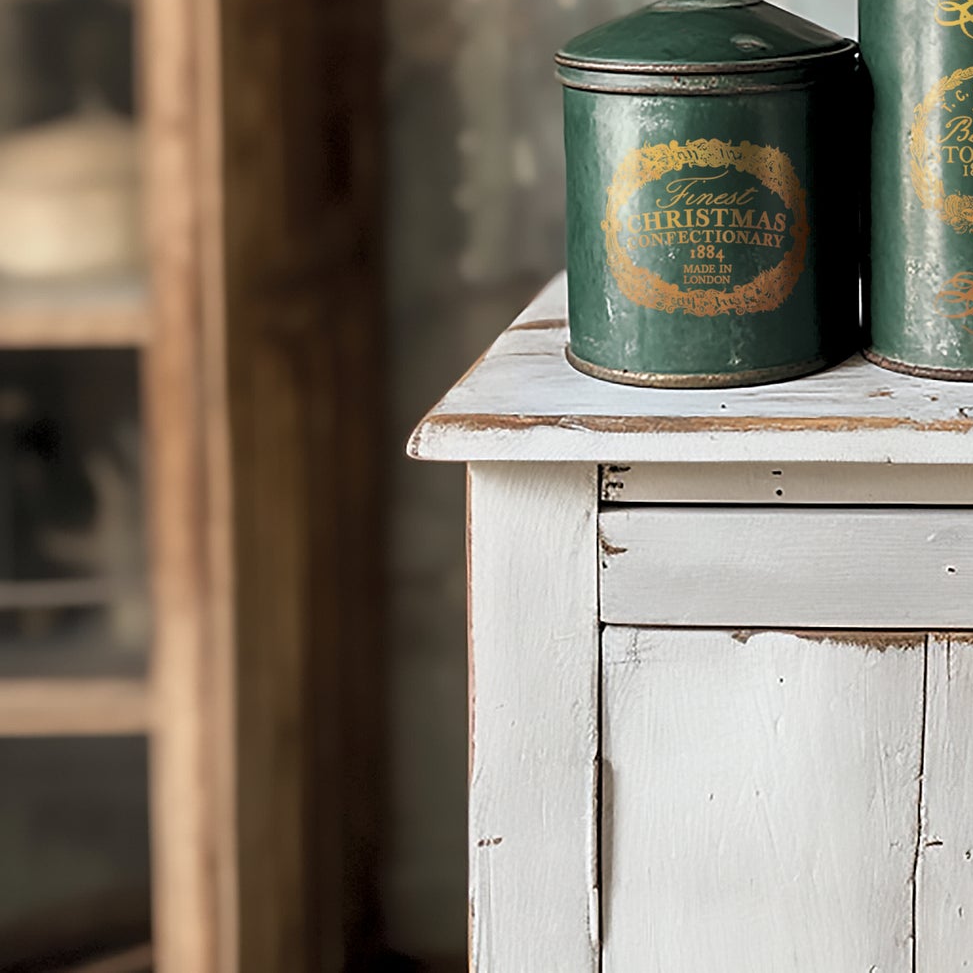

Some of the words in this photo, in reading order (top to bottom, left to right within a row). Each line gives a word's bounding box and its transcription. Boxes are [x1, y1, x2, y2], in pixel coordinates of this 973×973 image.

[955, 90, 969, 102] C.
[656, 170, 758, 209] Finest
[627, 208, 787, 233] CHRISTMAS
[627, 229, 785, 249] CONFECTIONARY
[690, 244, 725, 262] 1884
[683, 264, 716, 274] MADE
[719, 264, 732, 274] IN
[683, 275, 731, 285] LONDON
